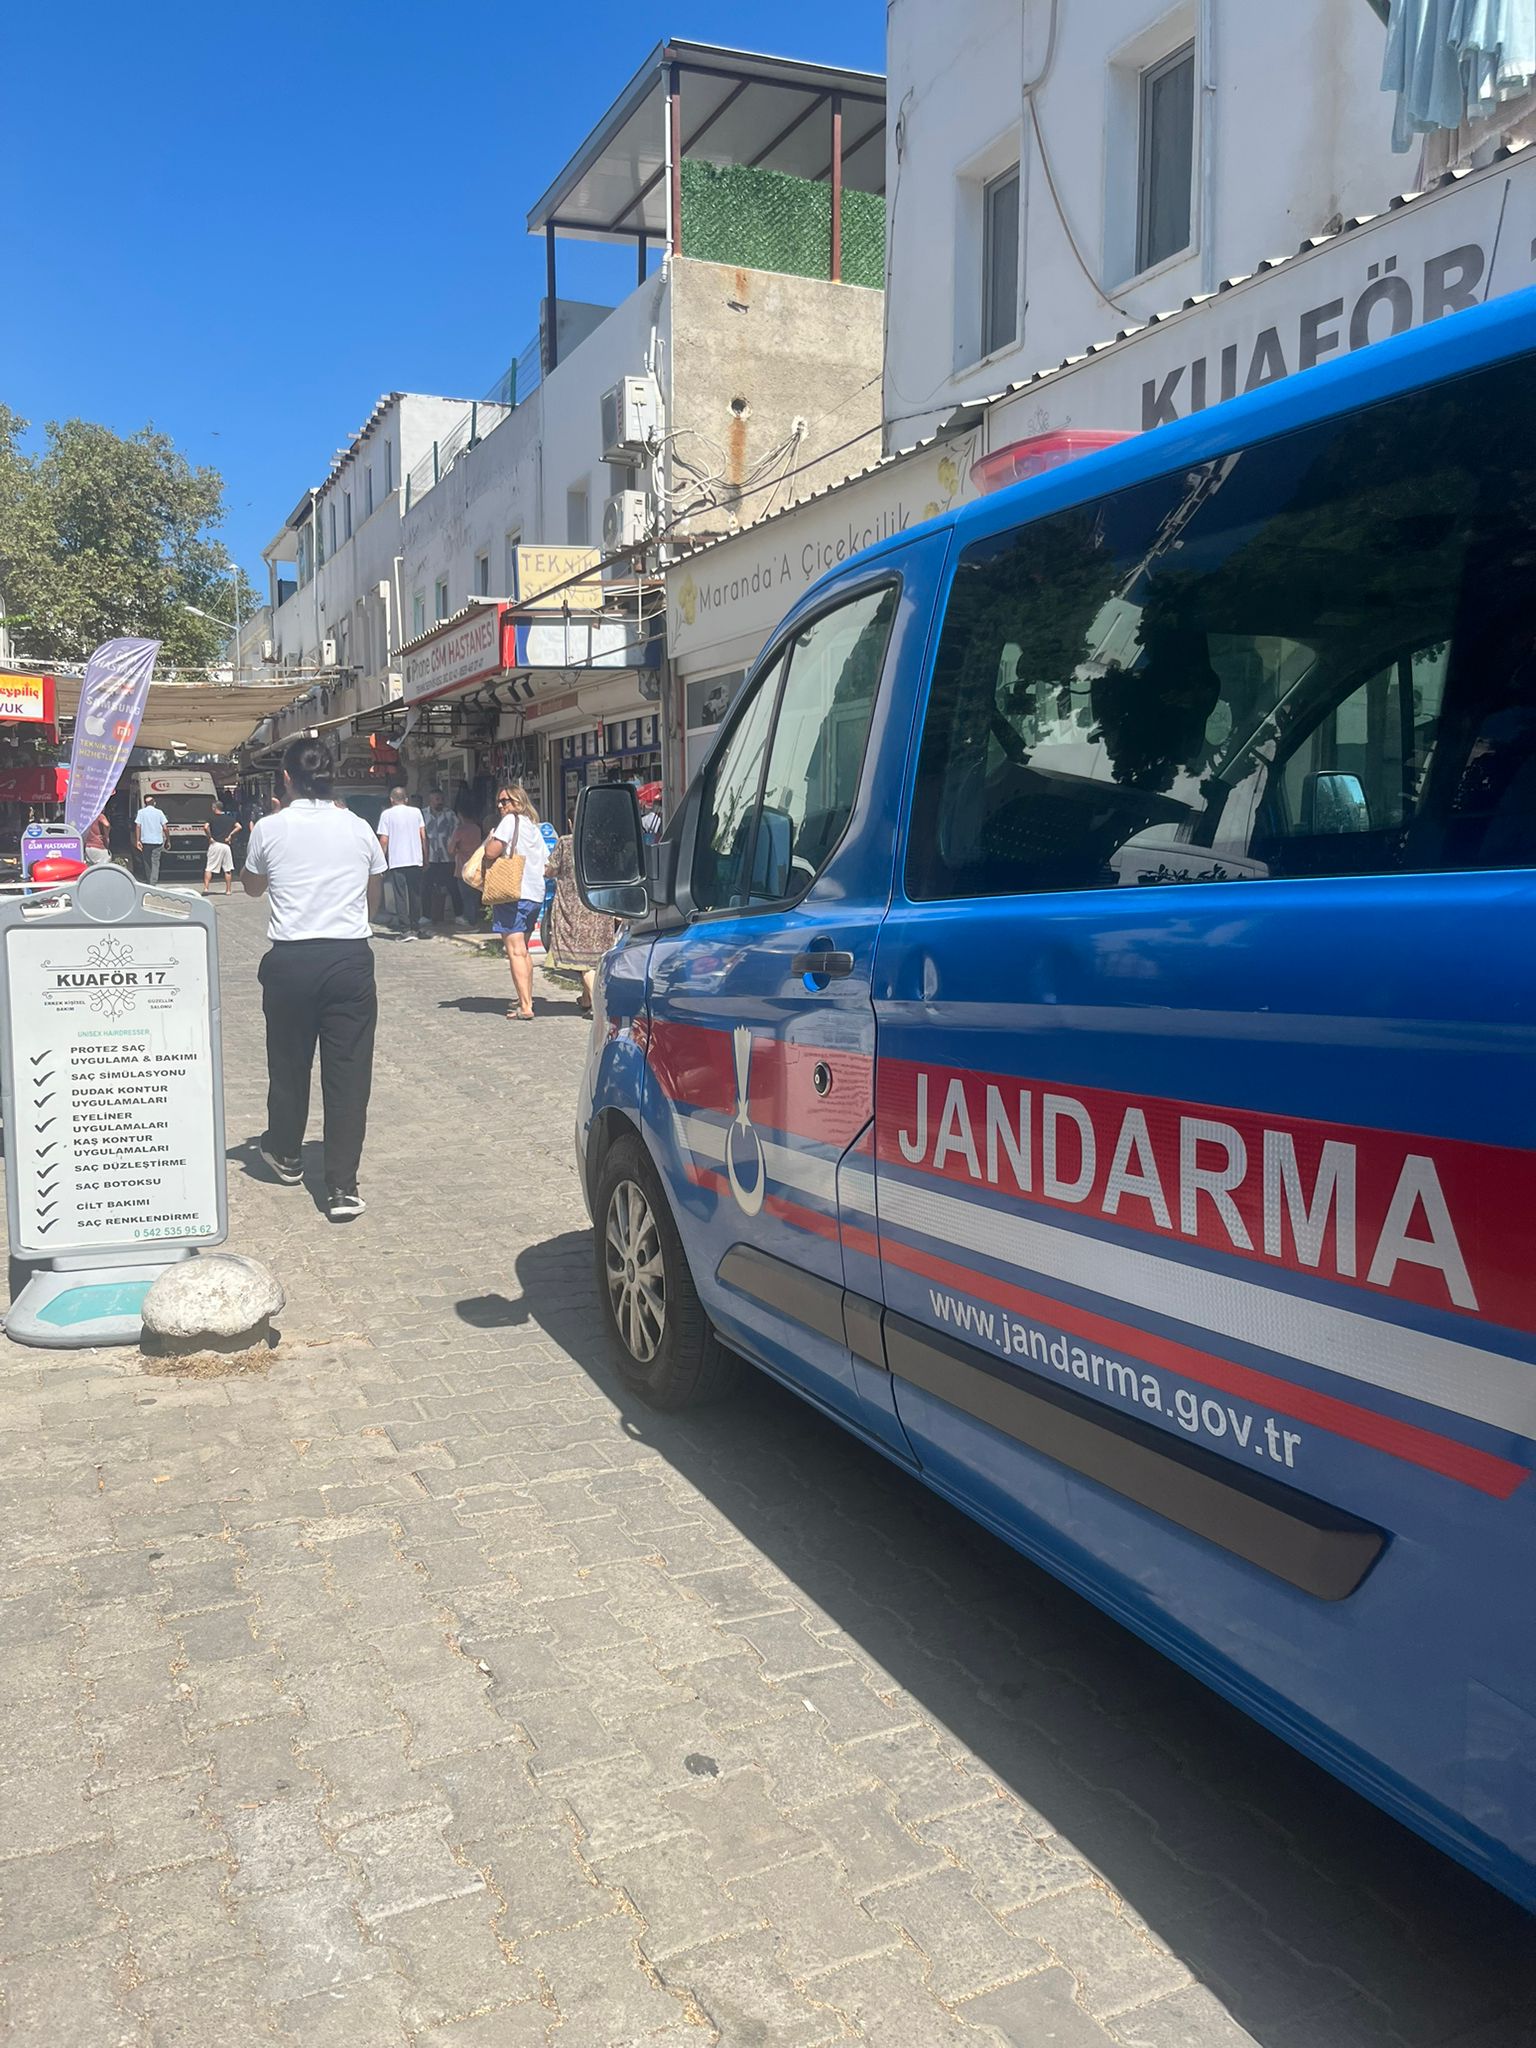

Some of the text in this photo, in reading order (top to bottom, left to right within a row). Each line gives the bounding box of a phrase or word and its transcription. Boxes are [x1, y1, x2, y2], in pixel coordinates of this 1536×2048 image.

[1142, 243, 1485, 432] KUAFÖR
[431, 644, 447, 672] GSM
[448, 611, 495, 665] HASTANESİ
[57, 971, 167, 987] KUAFÖR 17
[70, 1044, 146, 1054] PROTEZ SAÇ
[70, 1056, 139, 1065] UYGULAMA
[155, 1053, 198, 1062] BAKIMI
[71, 1073, 96, 1081] SAÇ
[71, 1085, 168, 1096] DUDAK KONTUR
[72, 1096, 168, 1108] UYGULAMALARI
[72, 1112, 133, 1122] EYELİNER
[73, 1121, 168, 1133] UYGULAMALARI
[73, 1134, 153, 1146] KAŞ KONTUR
[74, 1145, 170, 1157] UYGULAMALARI
[74, 1158, 188, 1172] SAÇ DÜZLEŞTİRME
[75, 1178, 161, 1191] SAÇ BOTOKSU
[898, 1072, 1480, 1312] JANDARMA
[76, 1199, 150, 1211] CİLT BAKIMI
[77, 1212, 200, 1228] SAÇ RENKLENDİRME
[134, 1224, 212, 1238] 0 542 535 95 62
[929, 1289, 1303, 1469] www.jandarma.gov.tr
